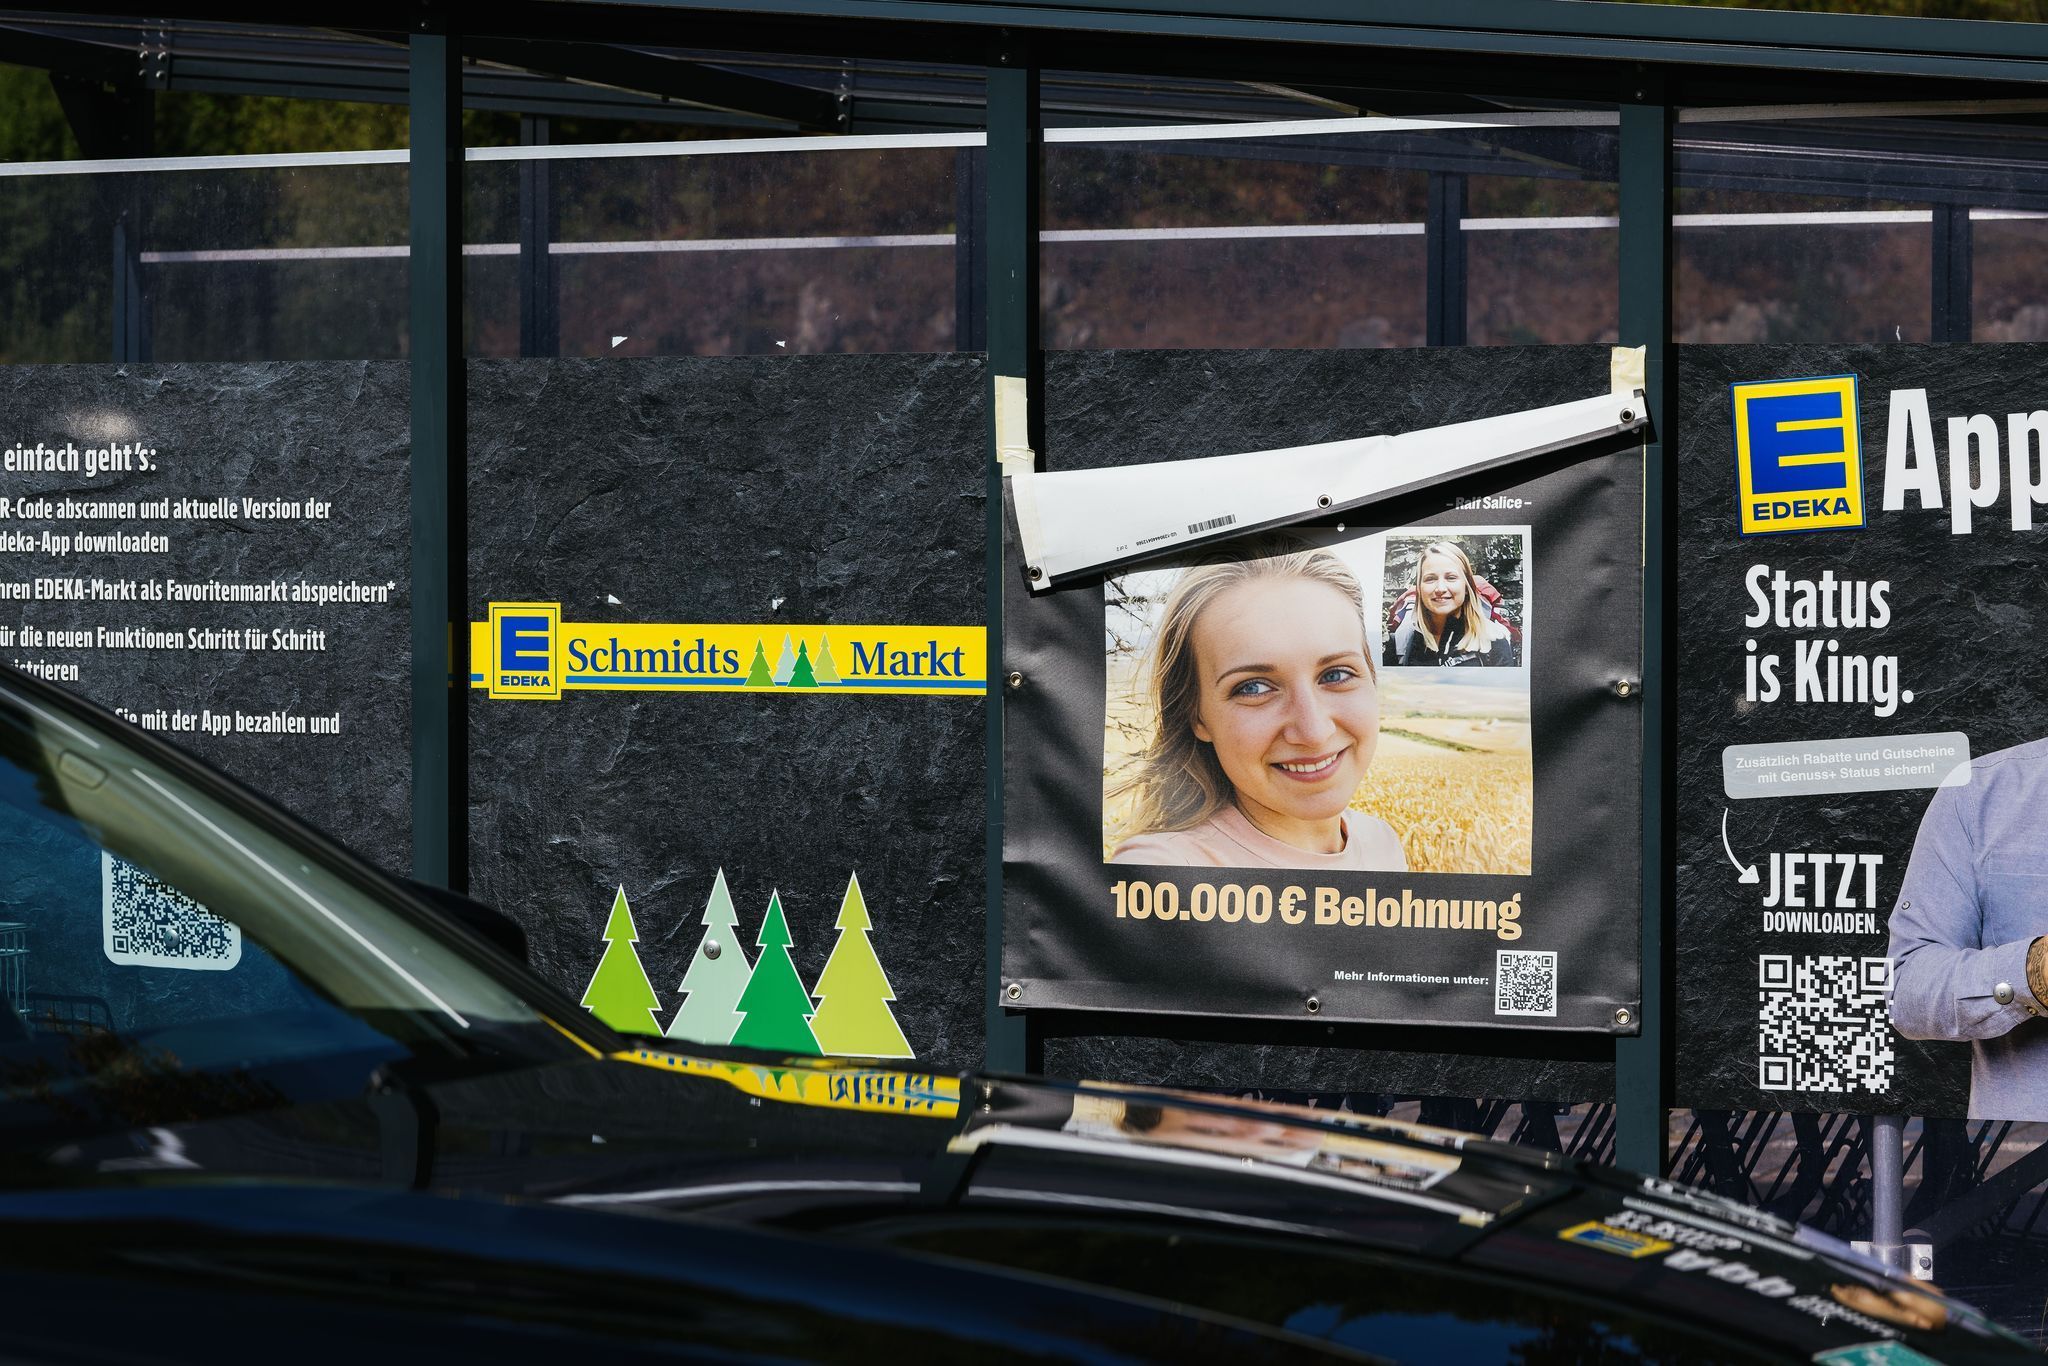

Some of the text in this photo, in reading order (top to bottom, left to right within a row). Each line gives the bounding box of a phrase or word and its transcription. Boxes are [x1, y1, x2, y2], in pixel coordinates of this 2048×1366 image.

[5, 443, 78, 471] einfach
[1883, 389, 2048, 534] App
[57, 498, 135, 518] abscannen
[141, 498, 168, 518] und
[174, 498, 237, 518] aktuelle
[243, 497, 300, 518] Version
[306, 498, 331, 518] der
[1483, 496, 1522, 509] Salice
[1753, 497, 1851, 521] EDEKA
[75, 532, 168, 552] downloaden
[35, 579, 136, 600] EDEKA-Markt
[141, 580, 162, 600] als
[167, 580, 287, 601] Favoritenmarkt
[1746, 565, 1890, 628] Status
[20, 626, 42, 646] die
[48, 631, 92, 647] neuen
[98, 627, 183, 648] Funktionen
[189, 628, 240, 649] Schritt
[245, 629, 267, 649] für
[273, 629, 325, 650] Schritt
[568, 638, 965, 678] Schmidts Markt
[500, 675, 550, 687] EDEKA
[1746, 639, 1913, 717] is King.
[142, 709, 167, 730] mit
[172, 710, 197, 730] der
[202, 710, 230, 735] App
[236, 711, 305, 733] bezahlen
[311, 713, 339, 733] und
[1736, 746, 1955, 769] Zusätzlich Rabatte und Gutscheine
[1758, 763, 1935, 783] mit Genuss+ Status sichern!
[1764, 853, 1882, 908] JETZT
[1111, 881, 1522, 940] 100.000 € Belohnung
[1764, 912, 1879, 934] DOWNLOADEN.
[1334, 970, 1489, 985] Mehr Informationen unter:
